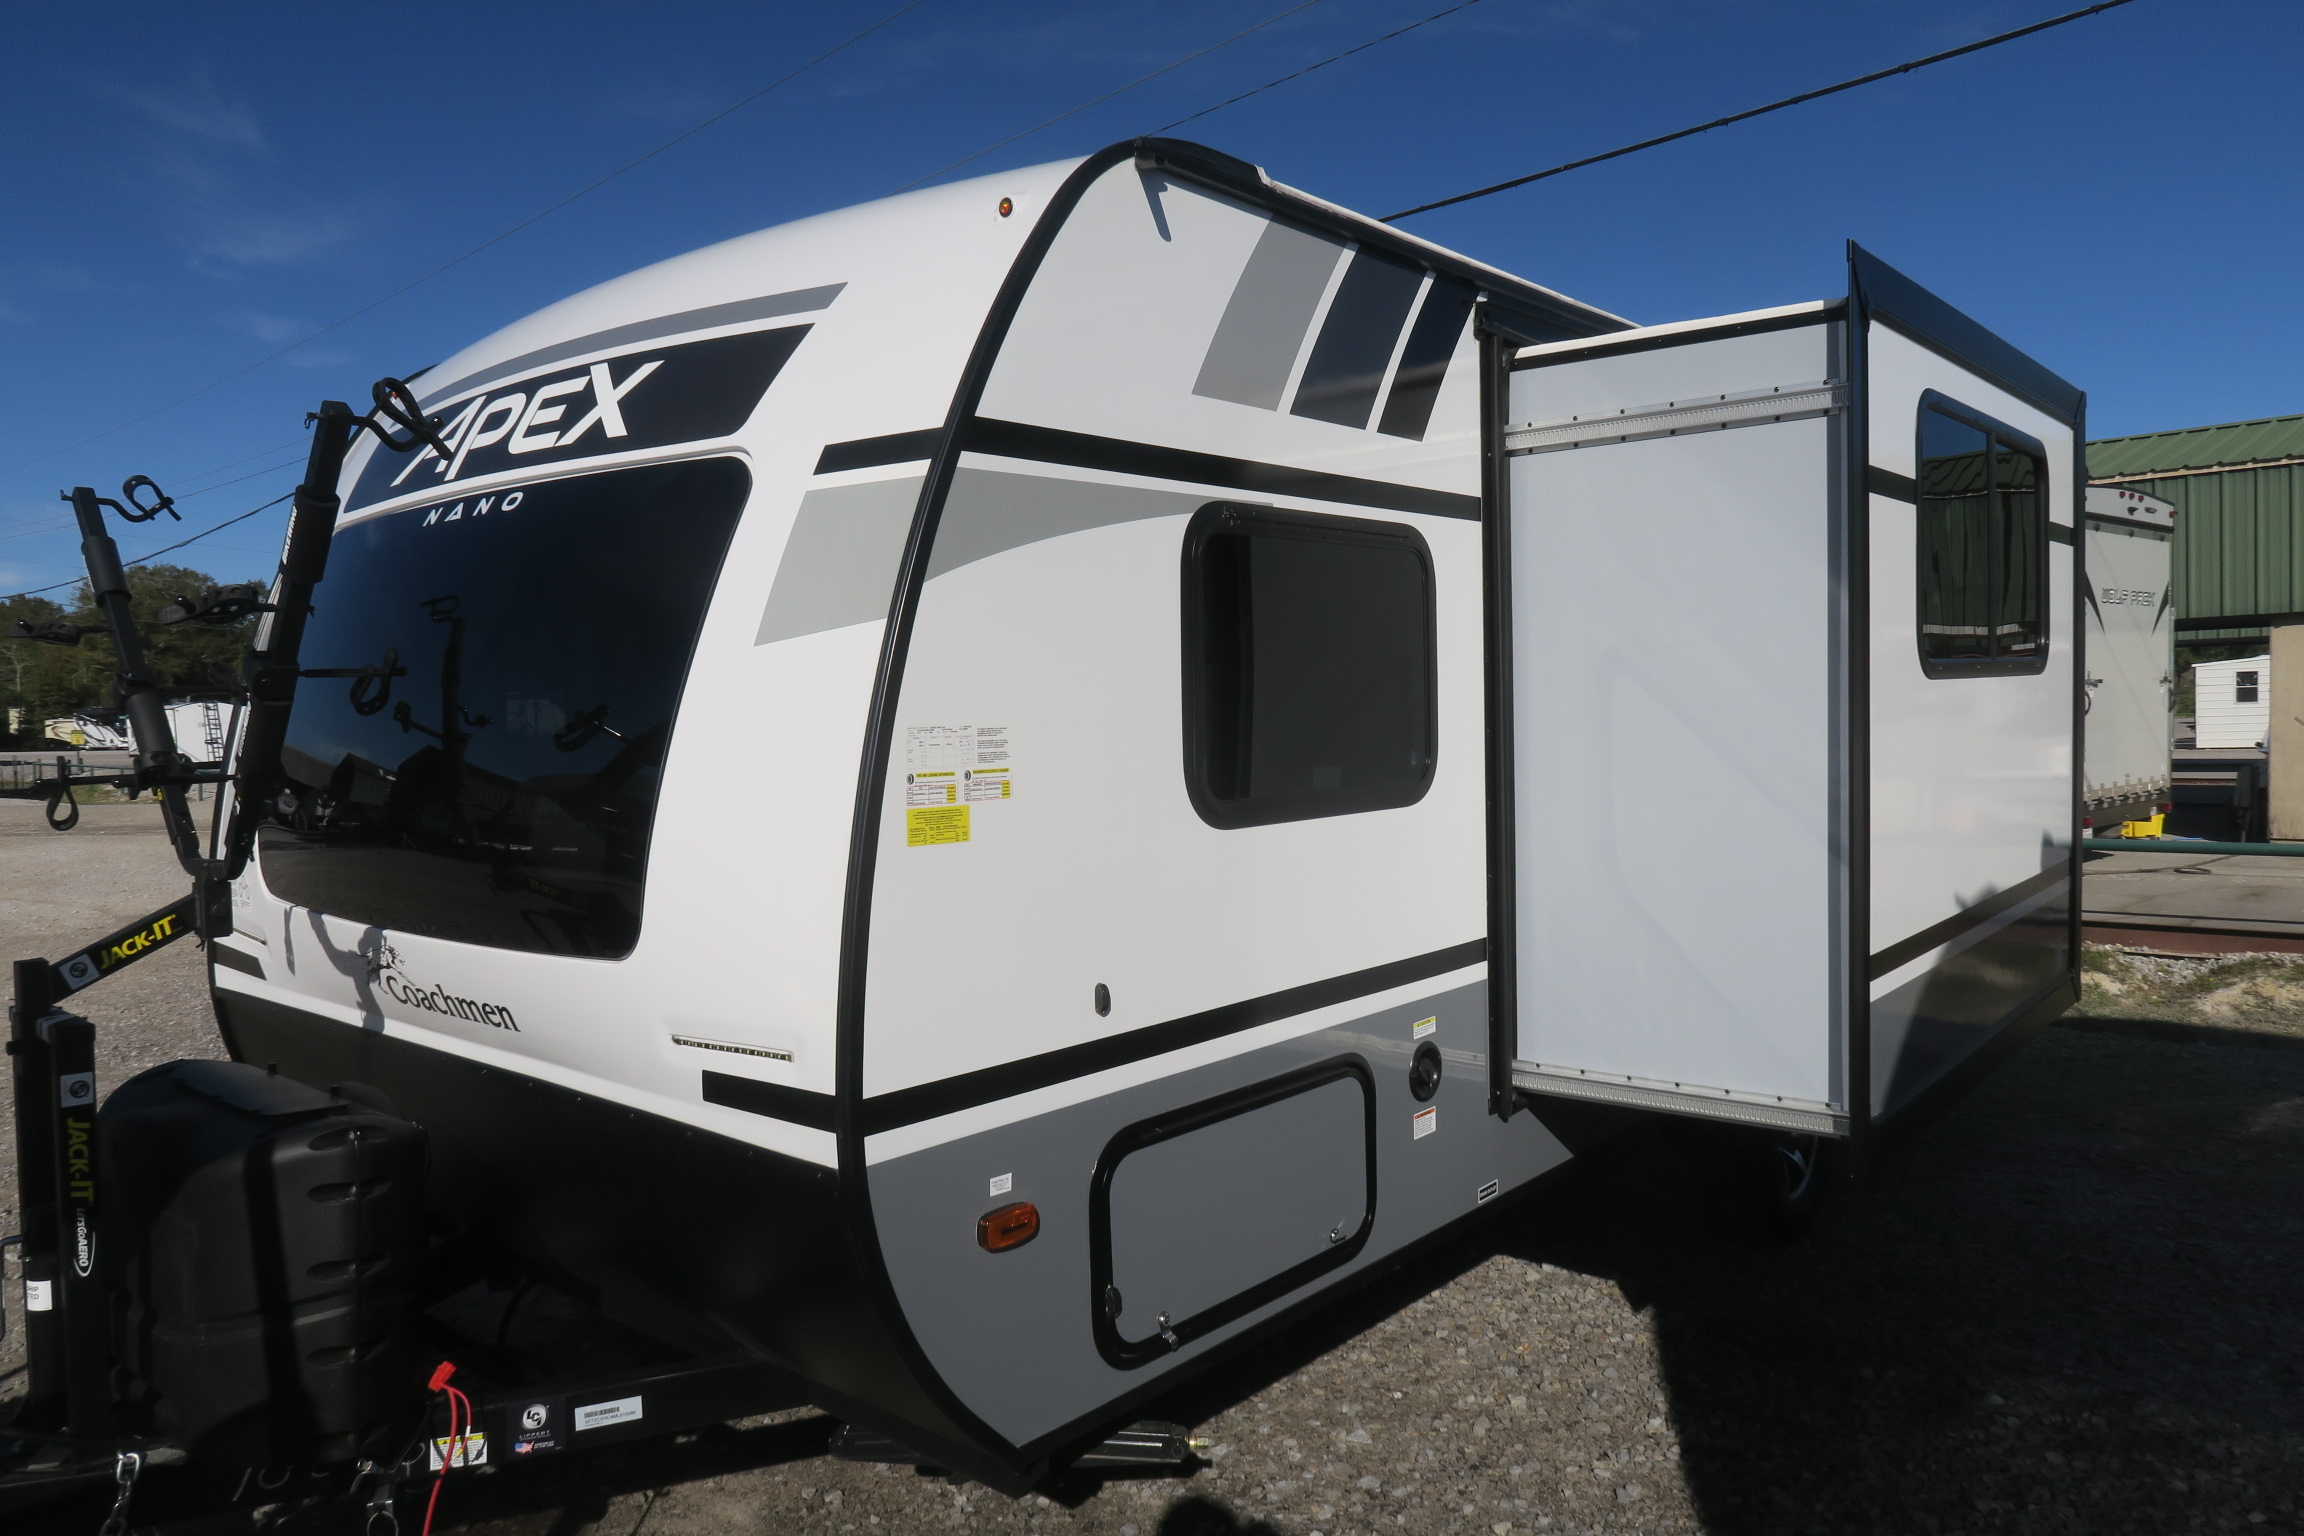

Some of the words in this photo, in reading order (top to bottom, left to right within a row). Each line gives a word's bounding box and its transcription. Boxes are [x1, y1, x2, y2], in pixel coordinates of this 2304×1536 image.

[390, 360, 665, 487] APEX
[422, 492, 524, 527] NANO
[101, 915, 175, 970] JACK-IT
[386, 975, 521, 1033] Coachmen
[67, 1118, 94, 1206] JACK-IT
[518, 1430, 551, 1439] LIPPERT
